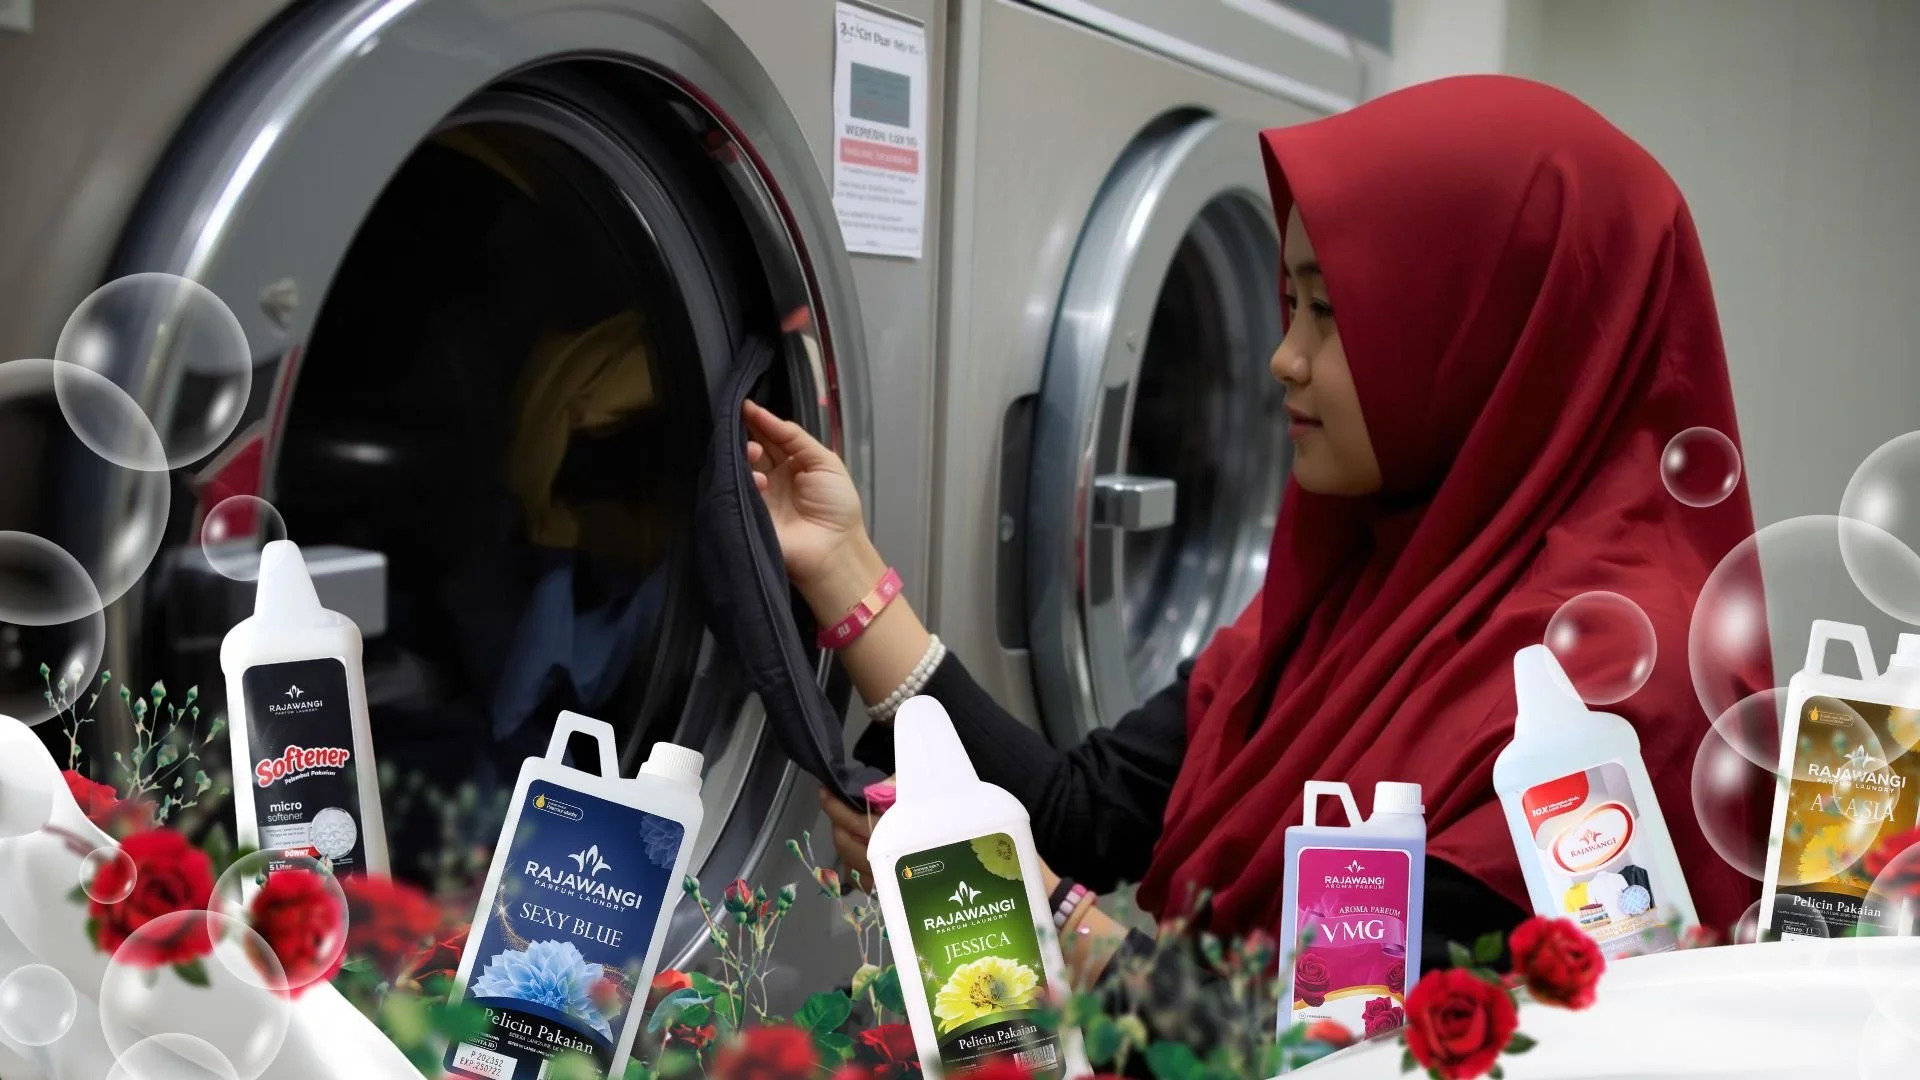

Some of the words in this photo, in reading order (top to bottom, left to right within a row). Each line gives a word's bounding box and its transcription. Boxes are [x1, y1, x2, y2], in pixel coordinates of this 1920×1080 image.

[269, 700, 323, 712] RAJAWANGI
[255, 744, 350, 788] Softener
[1808, 763, 1906, 789] RAJAWANGI
[1855, 783, 1895, 793] LAUNDRY
[267, 812, 303, 822] softener
[270, 801, 302, 812] micro
[1532, 806, 1549, 817] 10X
[1809, 793, 1895, 822] AASIA
[1570, 837, 1617, 857] RAJAWANGI
[524, 860, 643, 909] RAJAWANGI
[1324, 876, 1385, 885] RAJAWANGI
[534, 879, 574, 897] PARFUM
[579, 894, 626, 912] LAUNDRY
[1793, 895, 1833, 910] Pelicin
[1837, 901, 1881, 917] Pakaian
[923, 898, 1016, 931] RAJAWANGI
[1339, 905, 1369, 914] AROMA
[1370, 905, 1401, 917] PARFUM
[519, 902, 571, 930] SEXY
[571, 917, 623, 948] BLUE
[936, 923, 968, 935] PARFUM
[971, 913, 1008, 926] LAUNDRY
[944, 931, 1012, 964] JESSICA
[482, 1007, 532, 1036] Pelicin
[537, 1024, 593, 1055] Pakaian
[958, 1035, 995, 1050] Pelicin
[997, 1025, 1037, 1041] Pakaian
